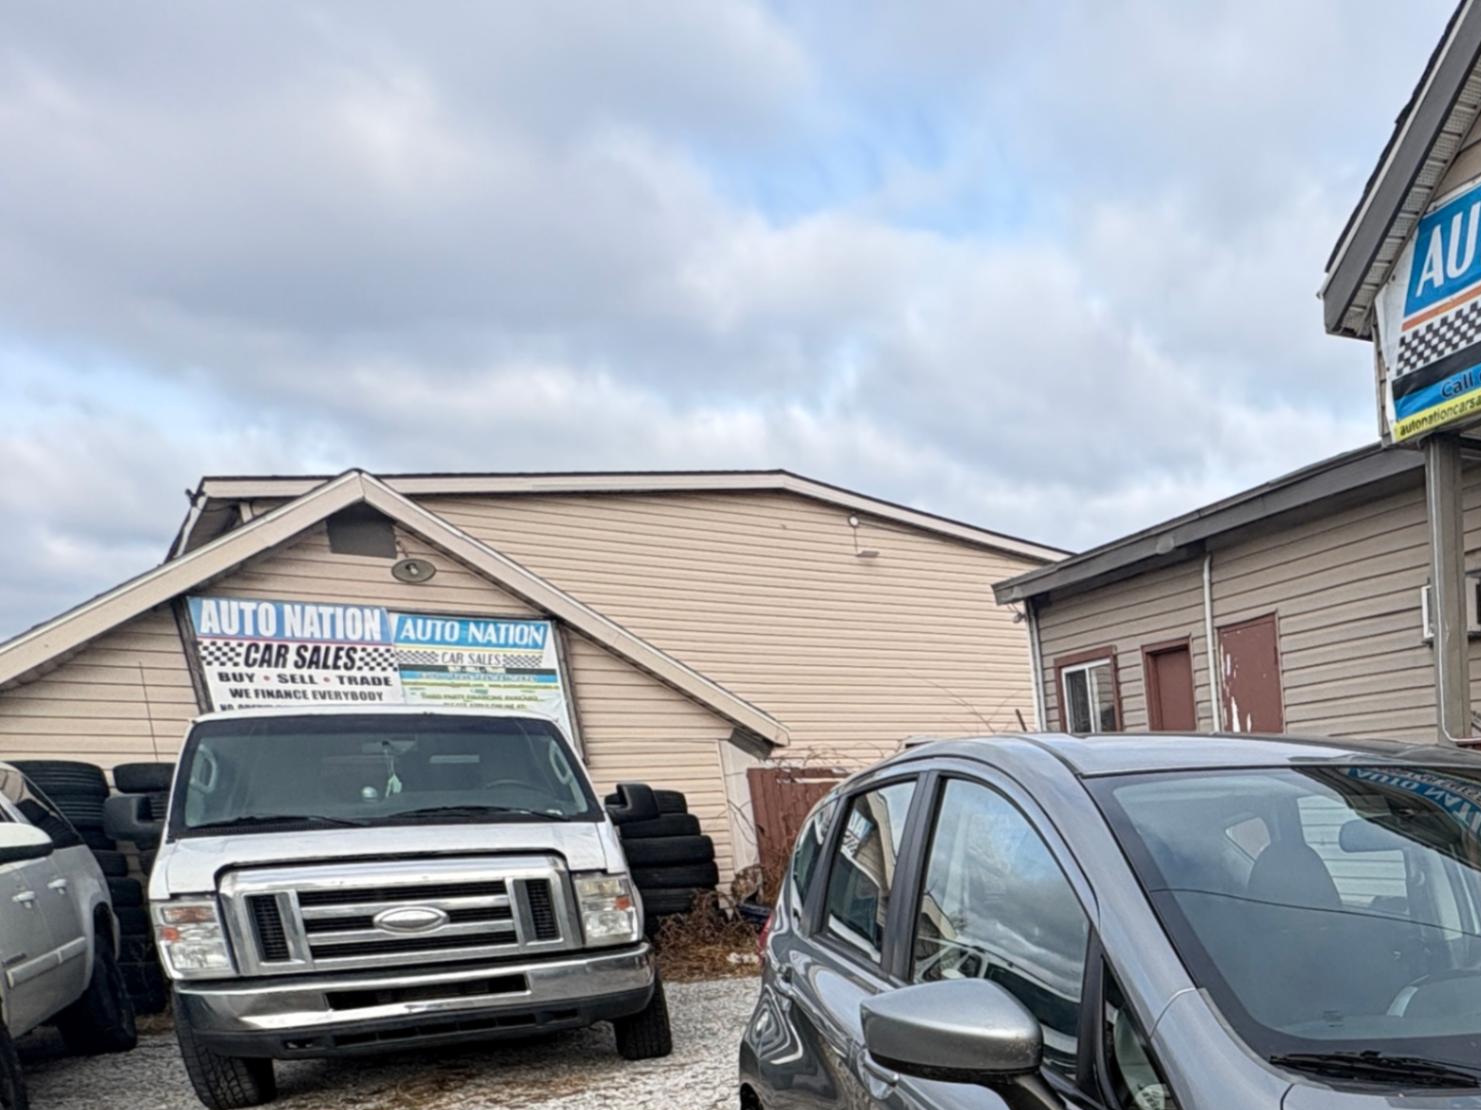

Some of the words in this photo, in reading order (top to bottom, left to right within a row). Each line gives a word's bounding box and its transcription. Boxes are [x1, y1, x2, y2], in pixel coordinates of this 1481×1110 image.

[1441, 373, 1475, 398] Call
[201, 599, 278, 637] AUTO
[284, 603, 381, 641] NATION
[400, 618, 456, 642] AUTO
[466, 621, 545, 647] NATION
[244, 642, 289, 669] CAR
[294, 645, 358, 671] SALES
[441, 653, 463, 665] CAR
[468, 653, 501, 666] SALES
[217, 672, 256, 683] BUY
[277, 674, 318, 685] SELL
[336, 675, 393, 687] TRADE
[229, 688, 252, 699] WE
[254, 688, 310, 700] FINANCE
[312, 690, 384, 701] EVERYBODY
